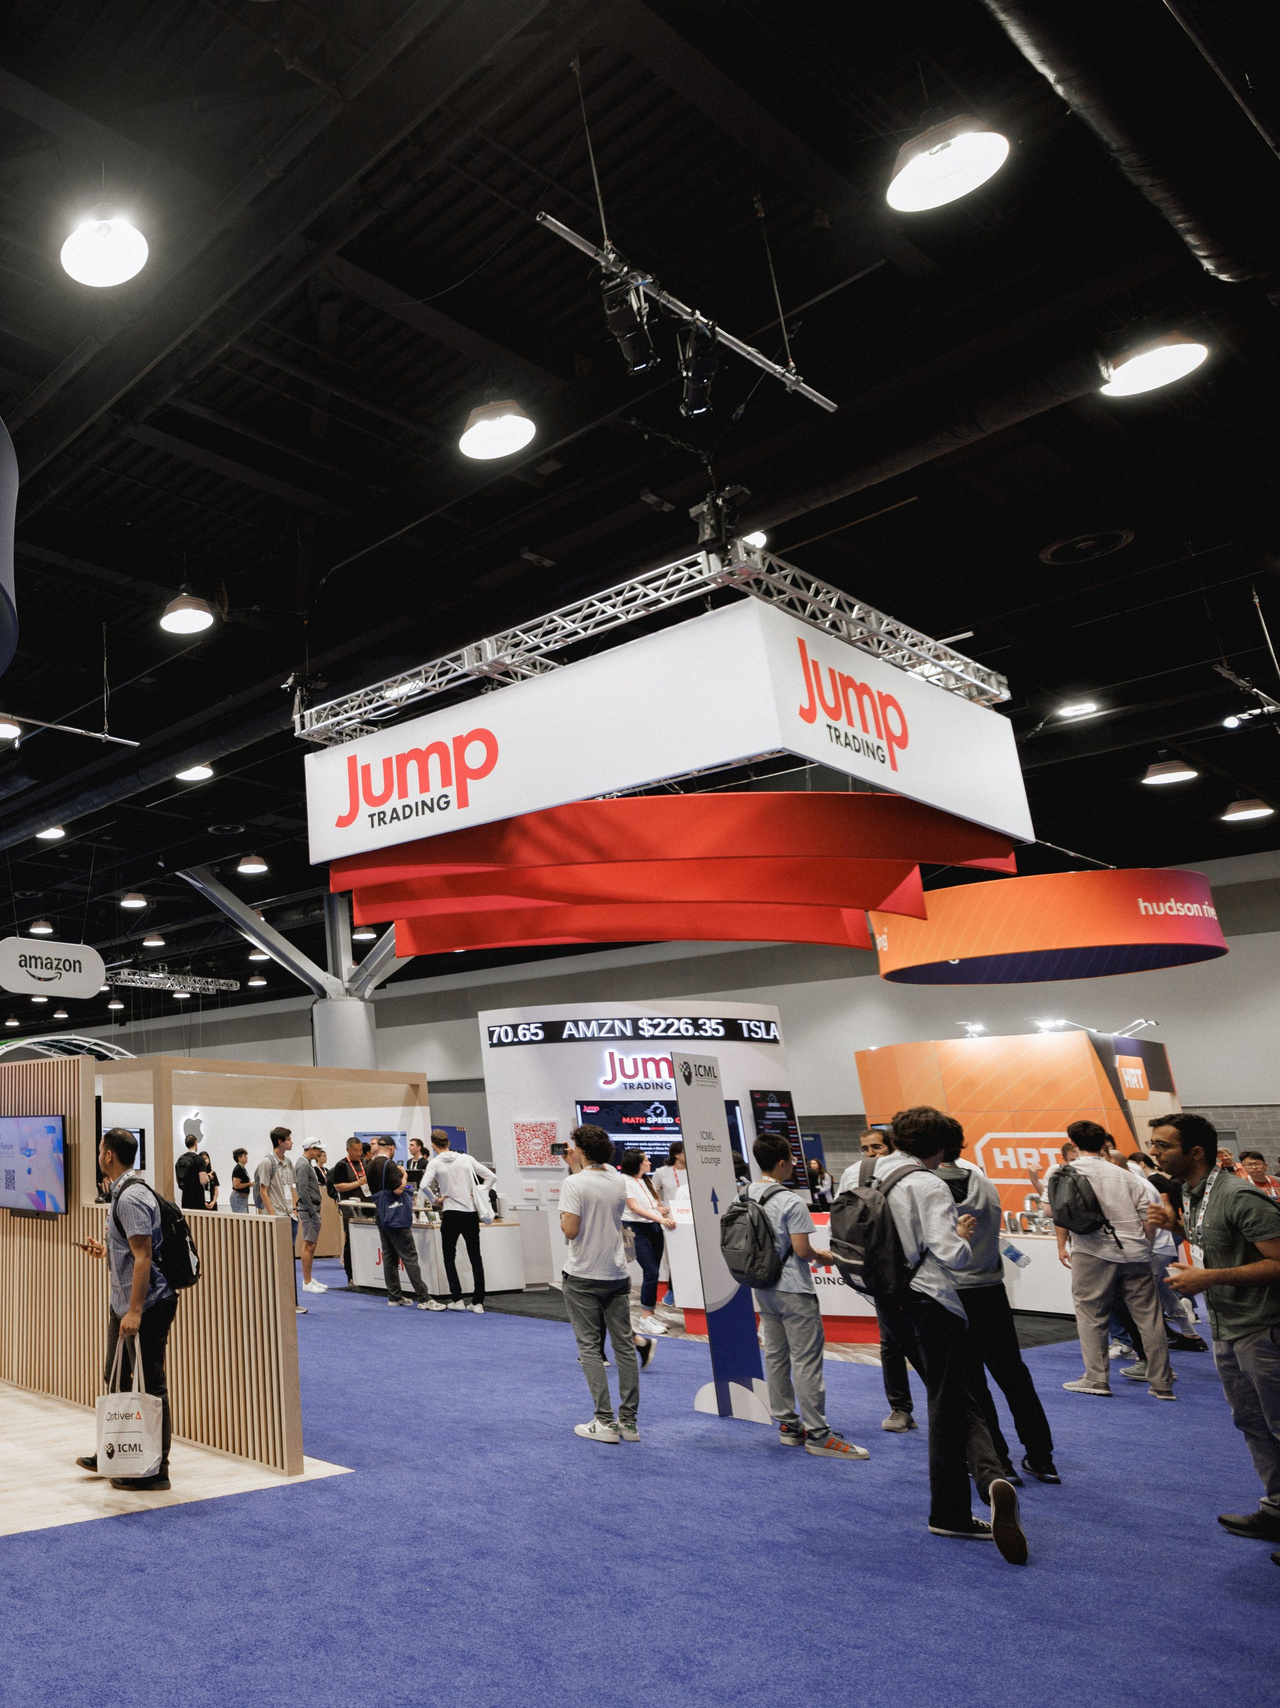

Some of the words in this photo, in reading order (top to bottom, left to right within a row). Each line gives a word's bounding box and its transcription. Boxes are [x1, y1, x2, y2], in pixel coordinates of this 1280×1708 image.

[797, 636, 910, 772] Jump
[826, 722, 888, 765] TRADING
[334, 727, 499, 829] Jump
[368, 793, 451, 829] TRADING
[1137, 897, 1203, 917] hudson
[18, 953, 83, 974] amazon
[489, 1022, 545, 1044] 70.65
[562, 1018, 634, 1039] AMZN
[637, 1016, 726, 1038] $226.35
[737, 1019, 781, 1040] TSLA
[602, 1051, 675, 1085] Jum
[694, 1064, 718, 1079] ICML
[622, 1081, 673, 1091] TRADING
[1121, 1067, 1145, 1089] HRT
[622, 1116, 646, 1124] MATH
[646, 1116, 674, 1124] SPEED
[700, 1130, 715, 1141] ICML
[1, 1142, 14, 1150] Forum
[696, 1143, 722, 1153] Headshot
[701, 1155, 721, 1167] Lounge
[992, 1147, 1061, 1169] HRT
[814, 1276, 845, 1285] DING
[106, 1411, 134, 1423] Optiver
[117, 1443, 143, 1453] ICML
